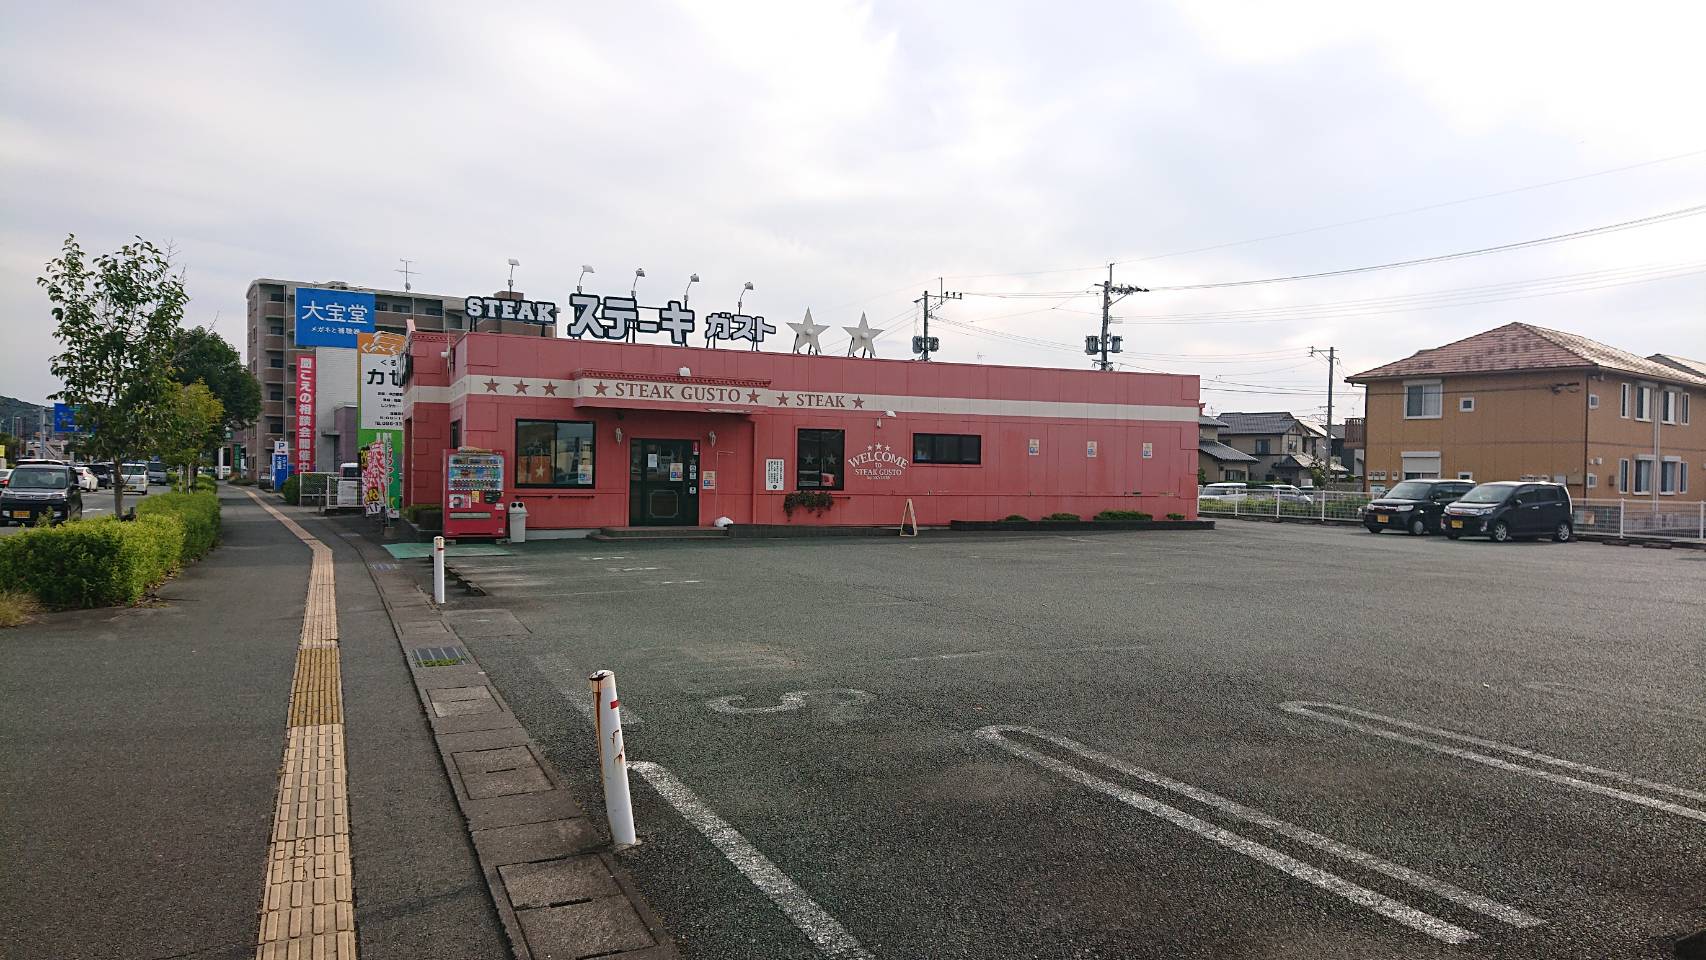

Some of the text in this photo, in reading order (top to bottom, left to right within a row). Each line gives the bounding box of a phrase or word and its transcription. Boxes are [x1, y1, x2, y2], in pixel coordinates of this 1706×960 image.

[301, 300, 368, 324] 大宝堂
[466, 296, 555, 324] STEAK
[568, 293, 695, 345] ステーキ
[705, 311, 776, 343] ガスト
[615, 382, 741, 403] STEAK GUSTO
[796, 392, 846, 409] STEAK
[278, 442, 285, 450] P
[847, 451, 909, 470] WELCOME
[855, 468, 902, 476] STEAK GUSTO
